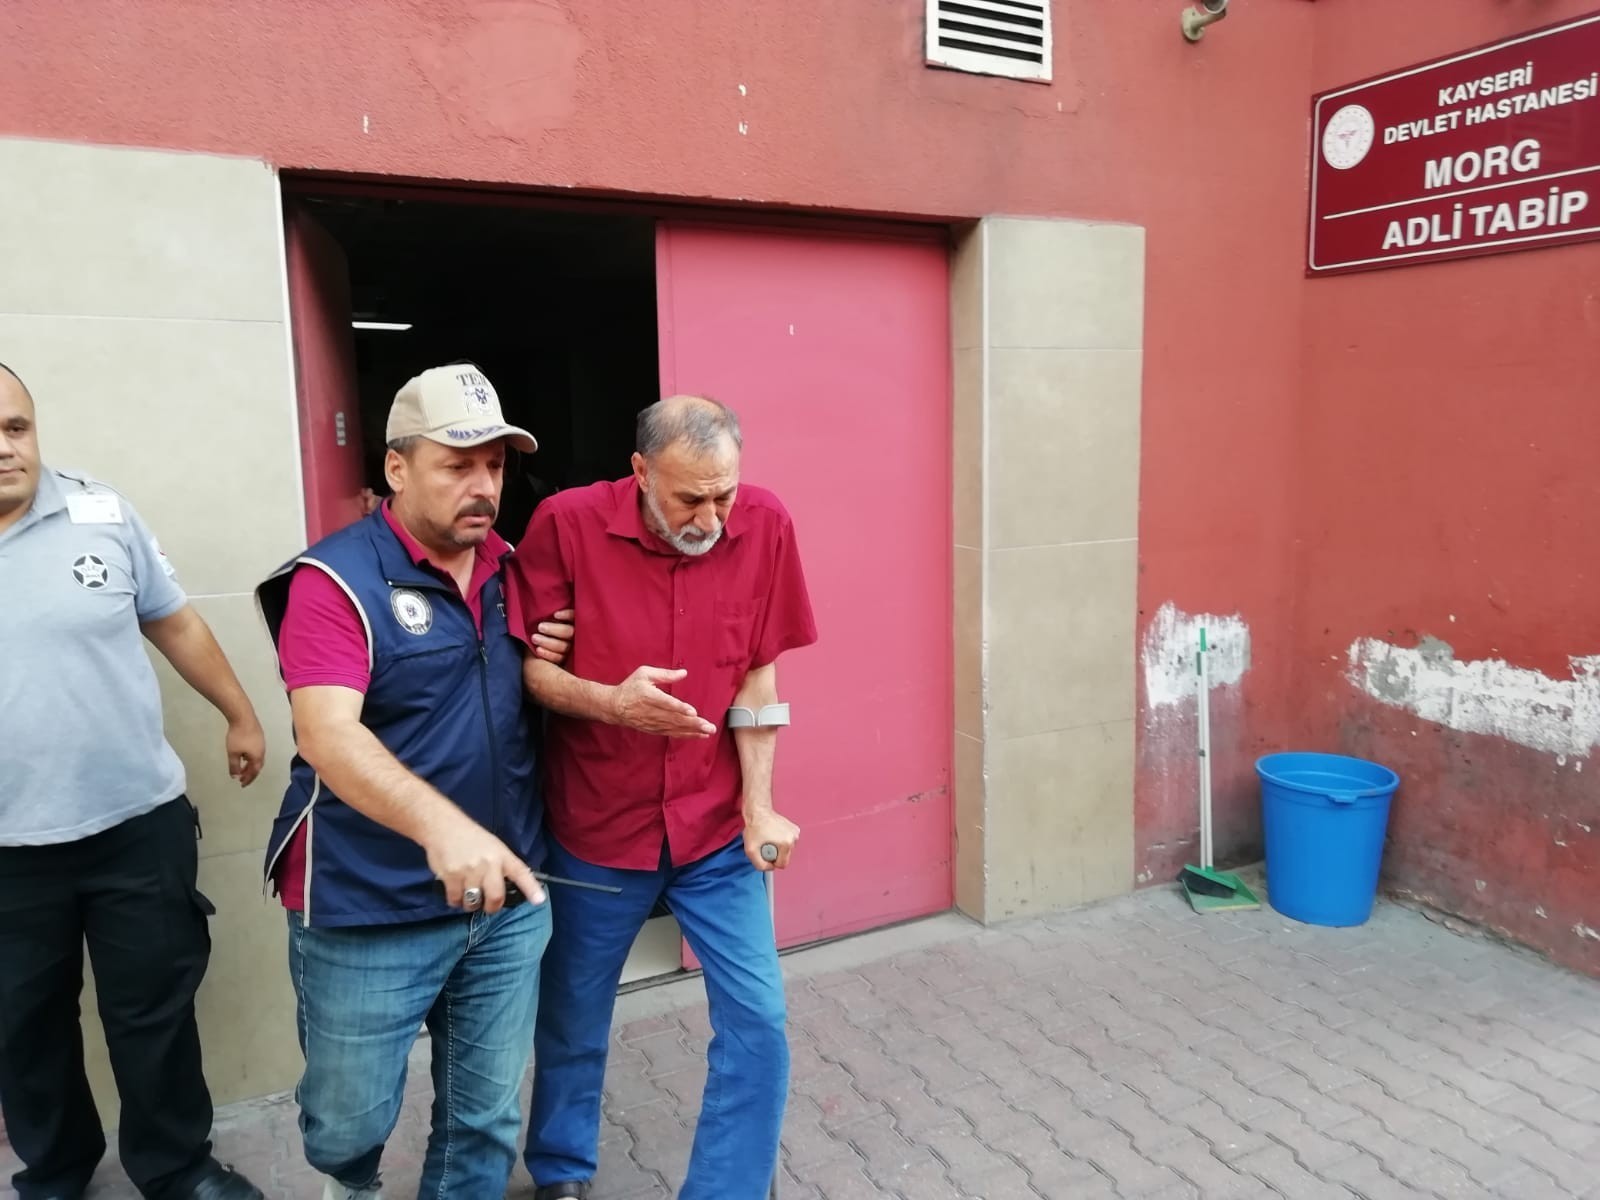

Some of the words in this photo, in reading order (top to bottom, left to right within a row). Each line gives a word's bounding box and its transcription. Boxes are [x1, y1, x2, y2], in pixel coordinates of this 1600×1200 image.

[1383, 111, 1462, 145] DEVLET
[1465, 72, 1599, 126] HASTANESİ
[1438, 61, 1533, 107] KAYSERİ
[1424, 138, 1541, 190] MORG
[1381, 203, 1463, 250] ADLİ
[1469, 187, 1589, 237] TABİP
